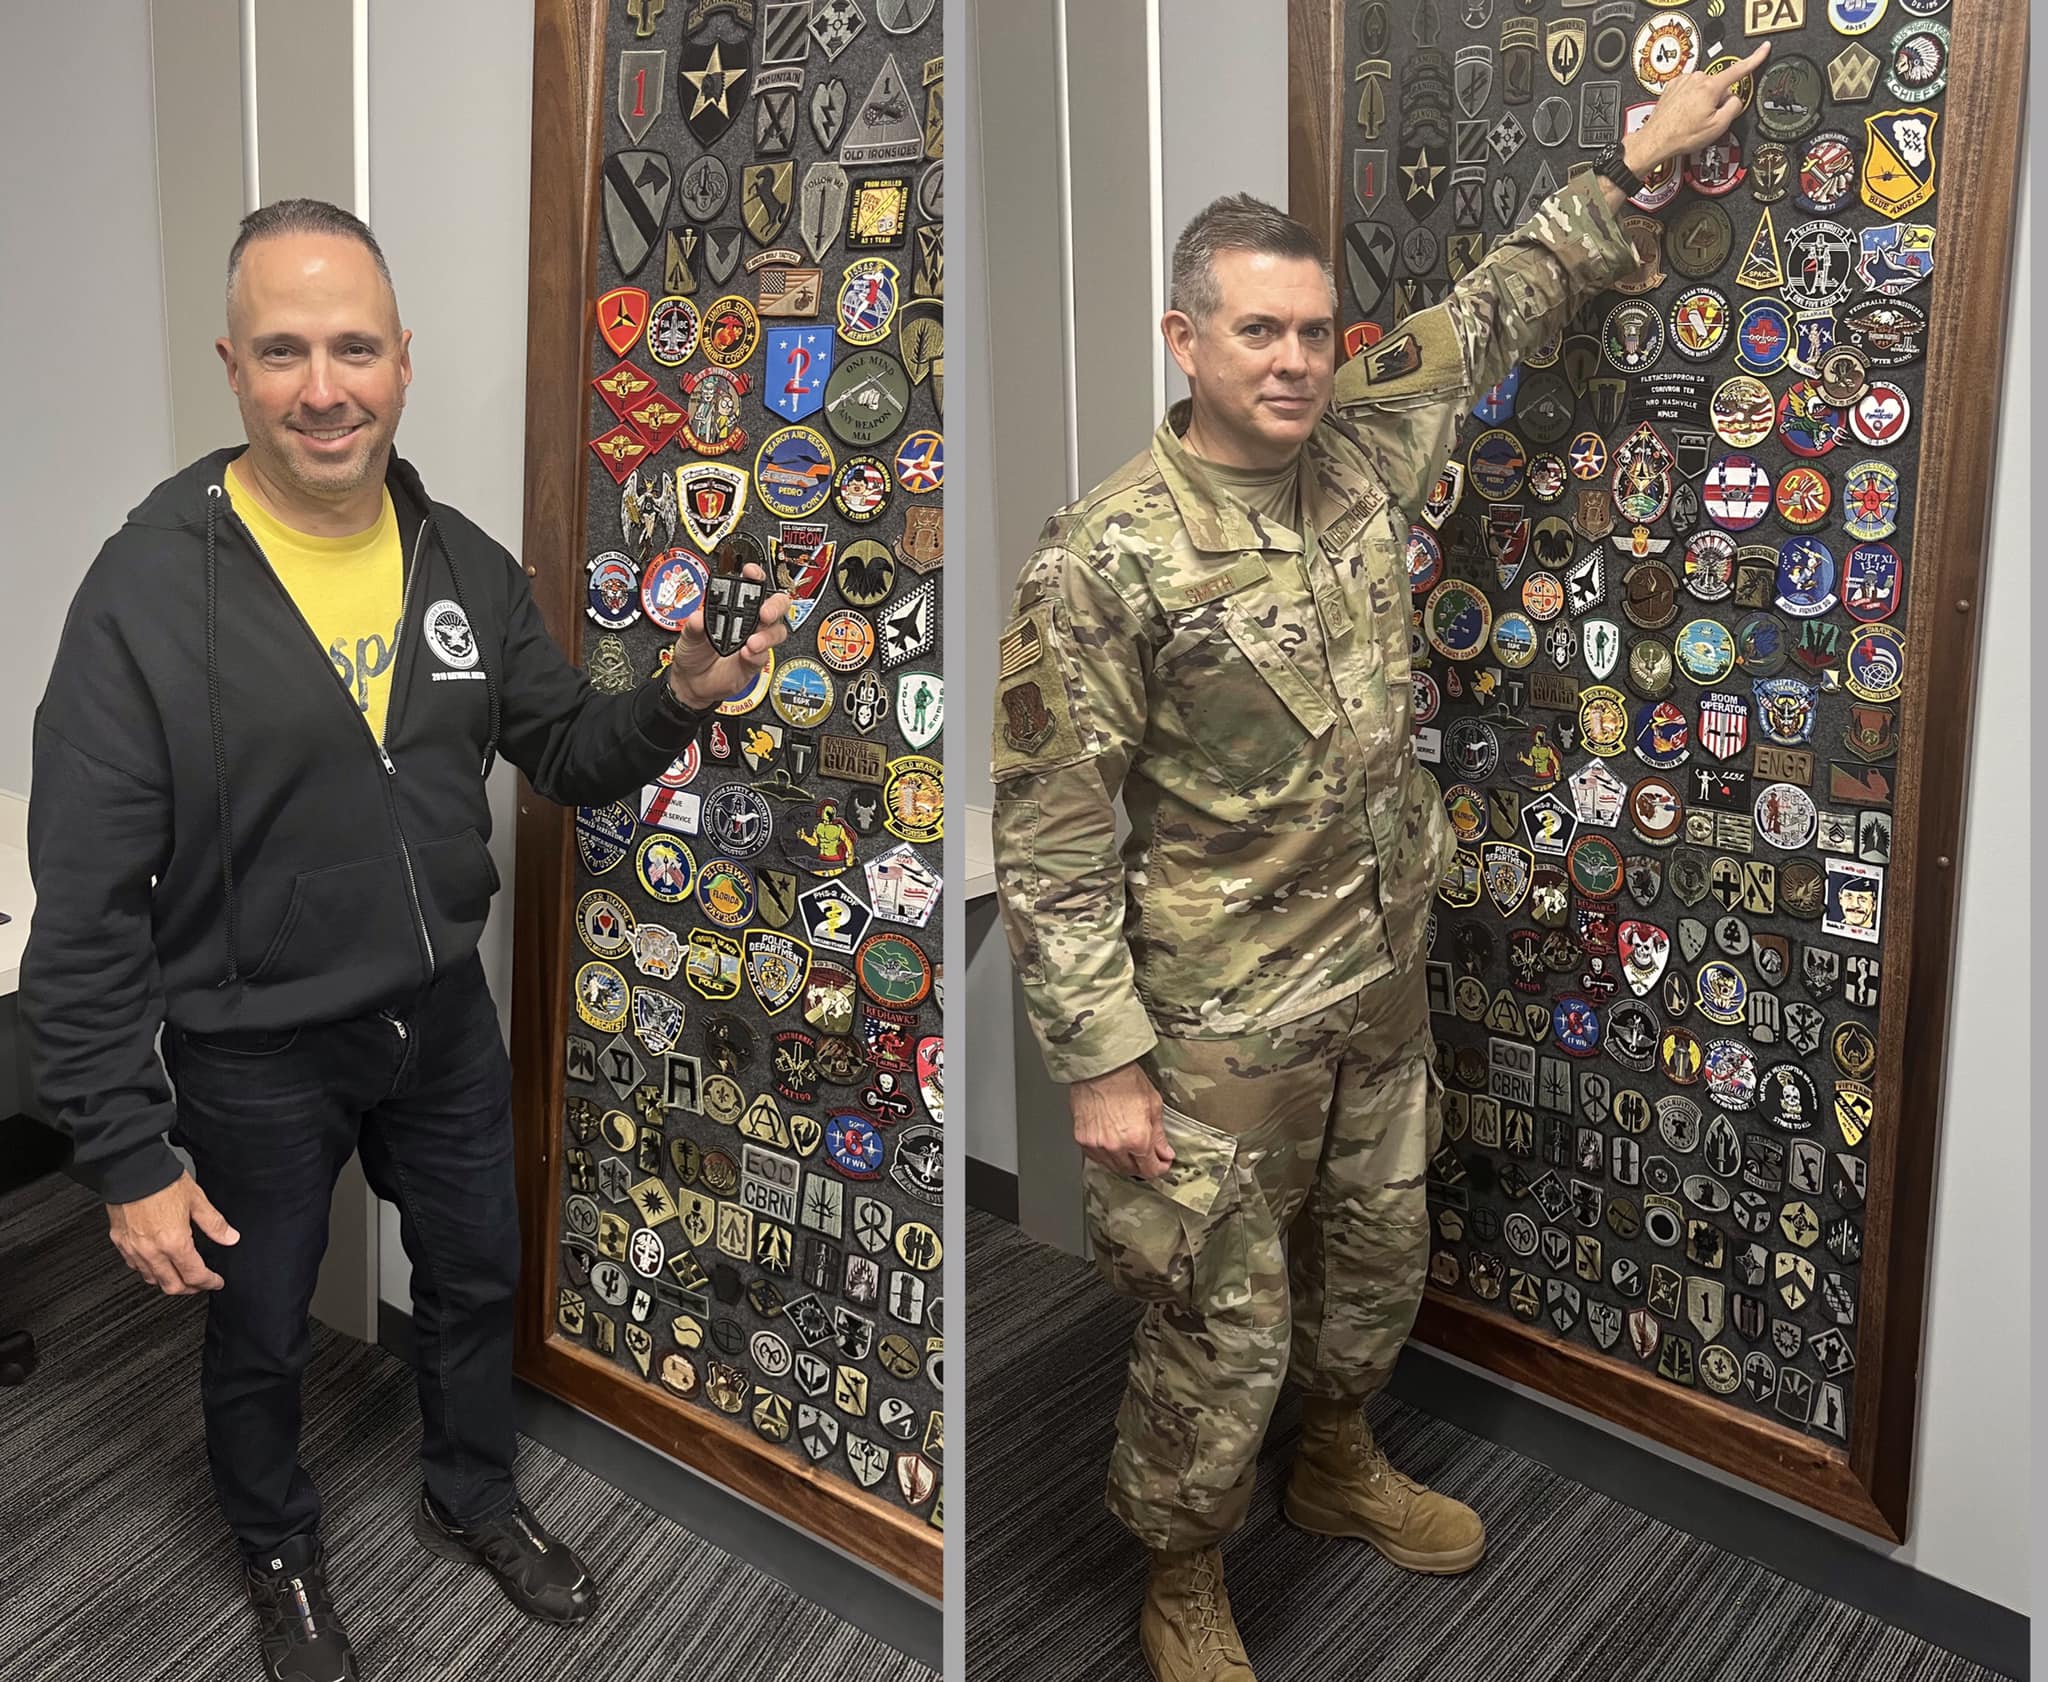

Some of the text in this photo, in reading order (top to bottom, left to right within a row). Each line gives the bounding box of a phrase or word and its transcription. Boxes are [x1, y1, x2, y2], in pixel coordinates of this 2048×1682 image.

[1751, 0, 1800, 29] PA
[758, 72, 801, 87] MOUNTAIN
[883, 78, 891, 94] 1
[633, 69, 646, 117] 1
[1890, 81, 1942, 101] CHIEFS
[844, 145, 918, 160] OLD IRONSIDES
[805, 176, 844, 191] FOLLOW ME
[1364, 162, 1375, 197] 1
[1868, 191, 1924, 215] BLUE ANGELS
[1798, 222, 1845, 236] BLACK KNIGHTS
[1749, 270, 1771, 278] SPACE
[1679, 288, 1697, 302] TEAM
[1804, 299, 1820, 308] FIVE
[708, 302, 754, 329] UNITED STATES
[1848, 298, 1887, 315] FEDERALLY
[703, 337, 750, 364] MARINE CORPS
[784, 347, 811, 394] 2
[846, 356, 894, 376] ONE MIND
[1662, 399, 1698, 410] NASHVILLE
[838, 408, 892, 429] ANY WEAPON
[765, 431, 829, 460] SEARCH AND RESCUE
[760, 484, 774, 506] MCAS
[772, 502, 800, 513] CHERRY
[801, 490, 823, 512] POINT
[778, 486, 804, 497] PEDRO
[1354, 487, 1383, 523] FORCE
[688, 519, 700, 537] LAVA
[783, 531, 822, 545] HITRON
[1739, 551, 1778, 564] AIRBORNE
[1854, 551, 1896, 564] SUPT XL
[1860, 561, 1886, 573] 13-14
[1184, 575, 1235, 604] SMITH
[1798, 604, 1823, 615] FIGHTER
[1556, 631, 1567, 645] K9
[860, 686, 876, 702] K9
[1711, 692, 1739, 705] BOOM
[730, 701, 754, 713] GUARD
[902, 682, 911, 725] JOLLY
[1700, 700, 1748, 716] OPERATOR
[826, 736, 870, 748] TENNESSEE
[826, 744, 869, 758] NATIONAL
[825, 753, 880, 777] GUARD
[898, 761, 914, 771] WILD
[1757, 751, 1809, 783] ENGR
[725, 784, 746, 793] SAFETY
[1447, 786, 1487, 812] HIGHWAY
[592, 808, 621, 827] POLICE
[668, 813, 692, 824] SERVICE
[754, 794, 770, 825] SECURITY
[758, 826, 769, 848] TEAM
[1534, 810, 1564, 849] 2
[719, 842, 748, 856] HOUSTON
[1495, 846, 1520, 859] POLICE
[1485, 853, 1528, 871] DEPARTMENT
[704, 863, 753, 895] HIGHWAY
[712, 889, 740, 906] FLORIDA
[840, 893, 859, 907] RDF
[1446, 888, 1468, 901] POLICE
[606, 894, 631, 922] HOUSE
[705, 902, 744, 923] PATROL
[813, 899, 852, 945] 2
[761, 934, 793, 950] POLICE
[748, 942, 804, 967] DEPARTMENT
[698, 979, 725, 992] POLICE
[747, 962, 803, 1007] CITY OF NEW YORK
[866, 1006, 916, 1024] REDHAWKS
[1708, 1039, 1754, 1059] EASY COMPANY
[1493, 1046, 1531, 1072] EOD
[1492, 1072, 1532, 1103] CBRN
[1660, 1099, 1699, 1118] RECRUITING
[1793, 1122, 1801, 1130] TO
[746, 1152, 794, 1186] EOD
[744, 1181, 793, 1219] CBRN
[1618, 1259, 1630, 1276] 9
[1700, 1291, 1713, 1324] 1
